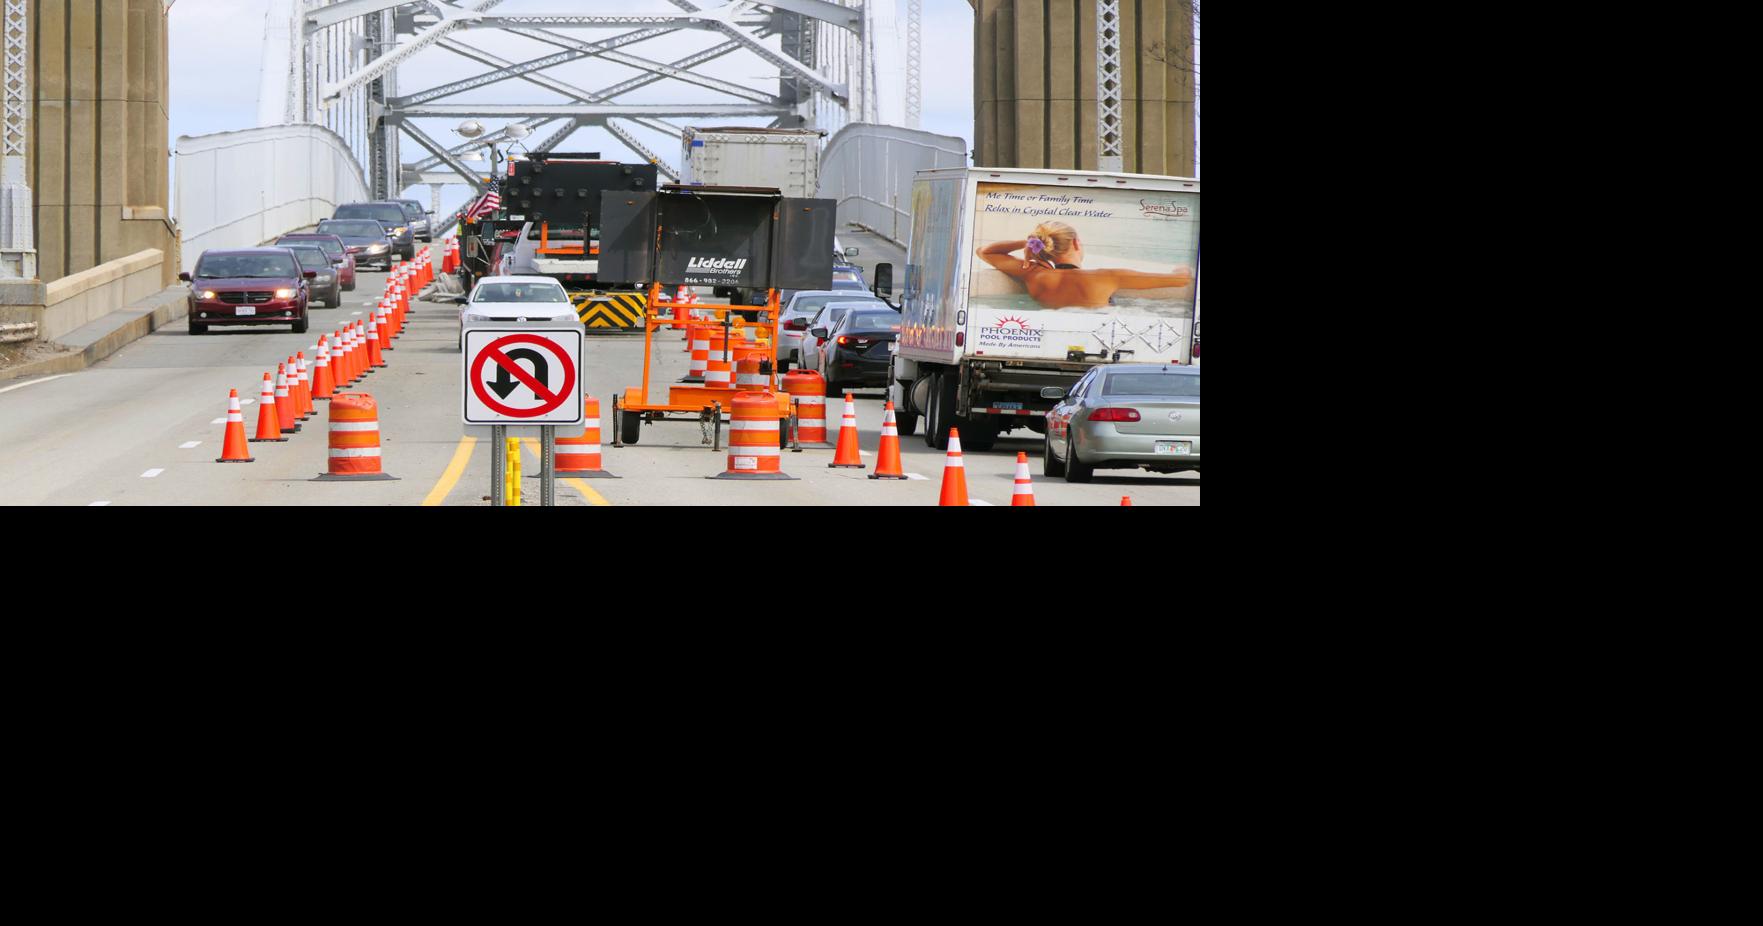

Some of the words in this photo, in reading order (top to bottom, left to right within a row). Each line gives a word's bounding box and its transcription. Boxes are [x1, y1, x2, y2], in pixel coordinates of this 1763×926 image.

[986, 192, 1000, 200] Me
[1039, 194, 1070, 205] Family
[1072, 196, 1094, 204] Time
[985, 204, 1009, 213] Relax
[1012, 206, 1021, 214] in
[1023, 206, 1057, 217] Crystal
[1059, 207, 1082, 216] Clear
[1084, 210, 1113, 218] Water
[687, 256, 747, 269] Liddell
[981, 327, 1041, 335] PHOENIX
